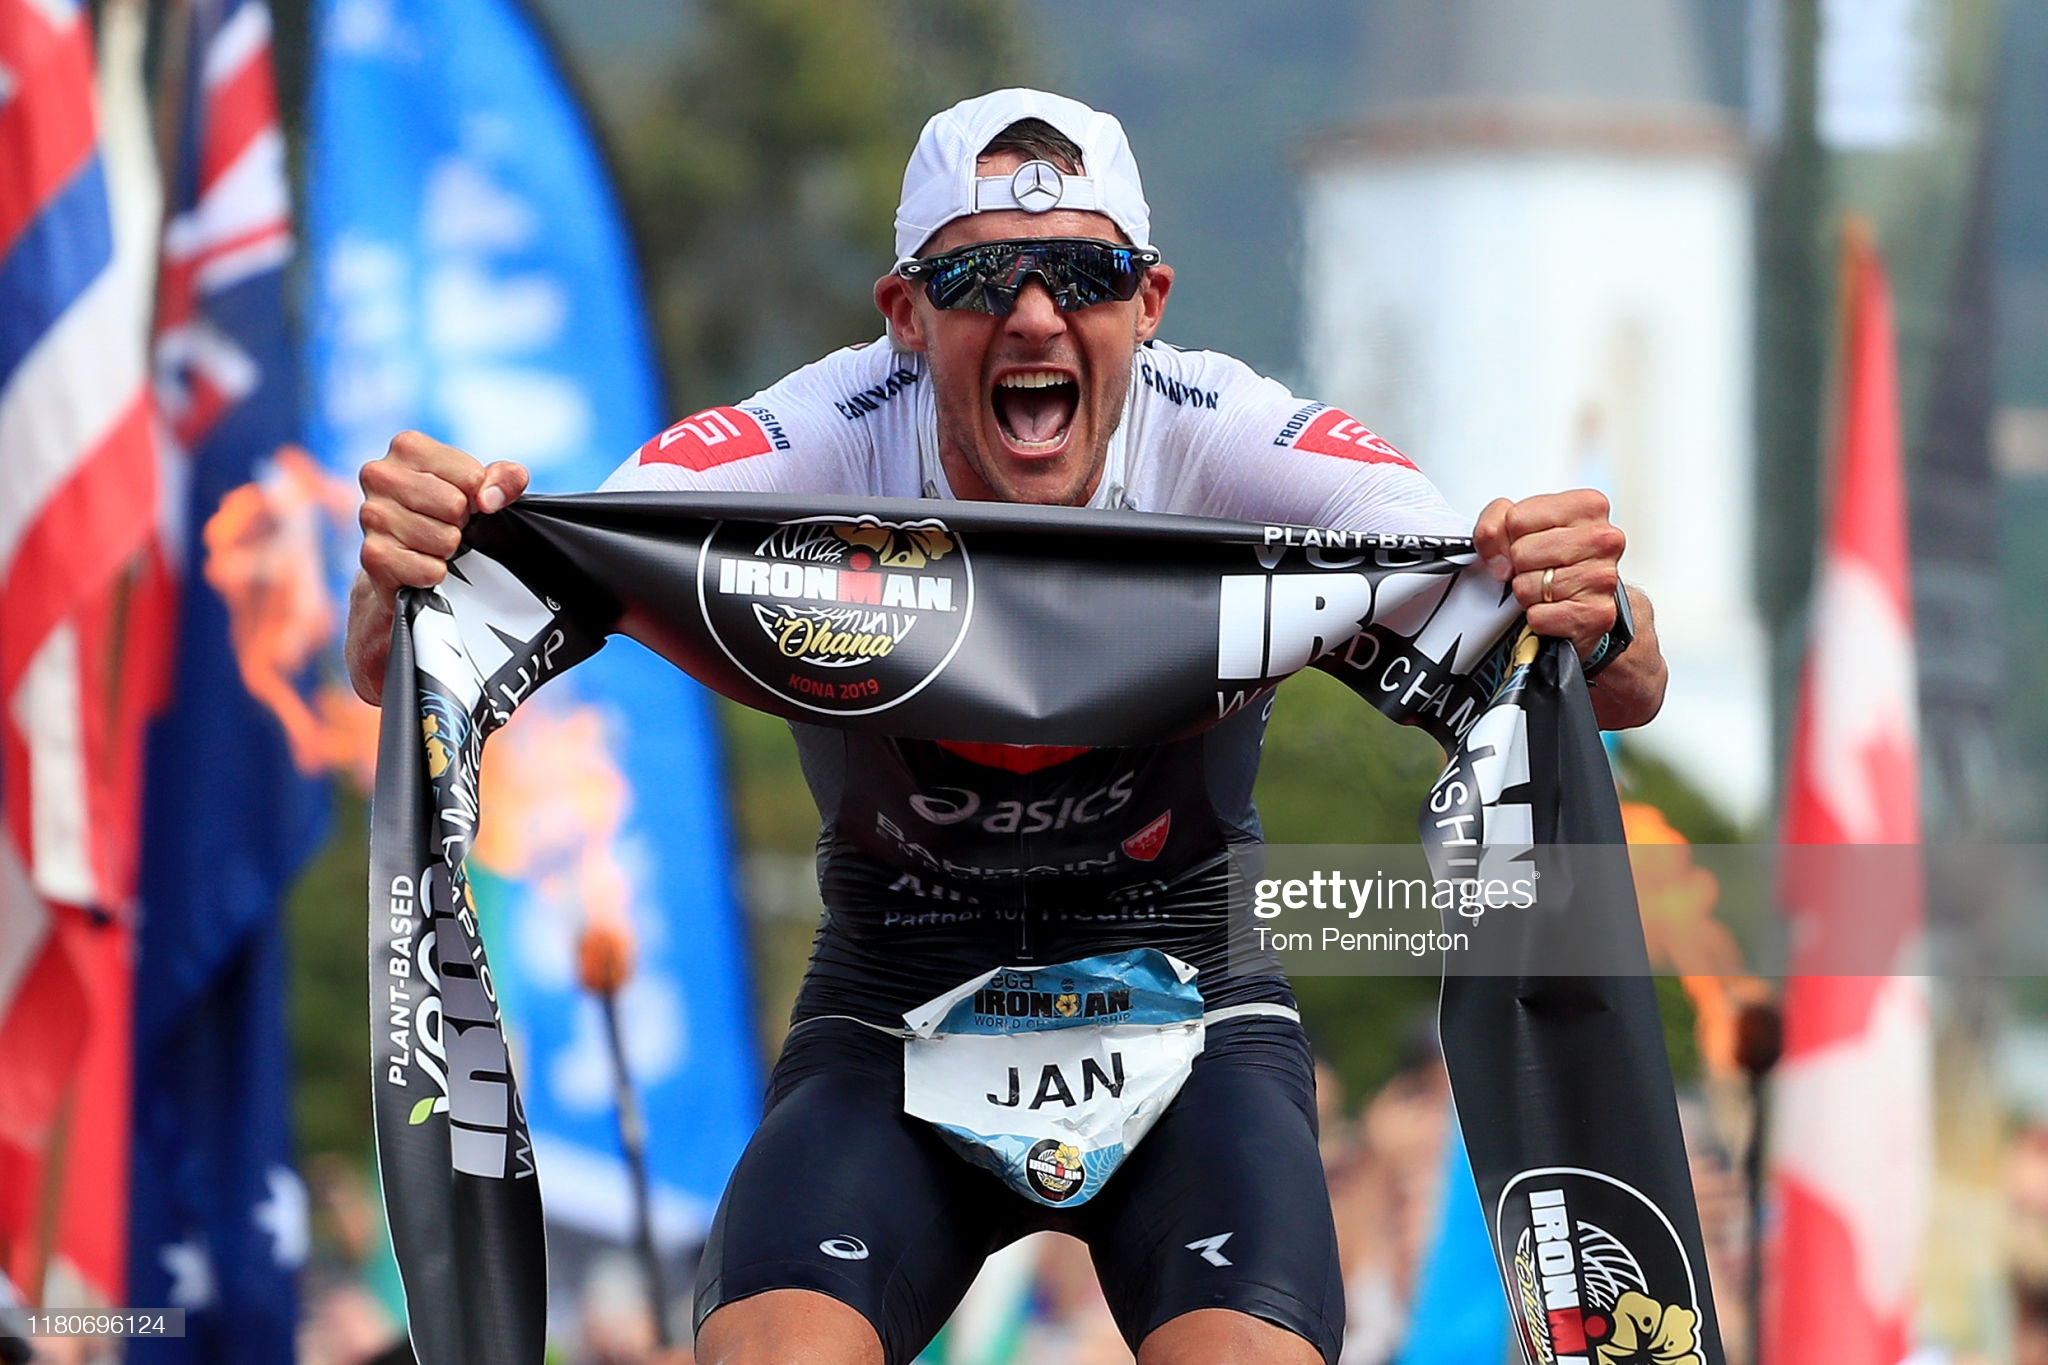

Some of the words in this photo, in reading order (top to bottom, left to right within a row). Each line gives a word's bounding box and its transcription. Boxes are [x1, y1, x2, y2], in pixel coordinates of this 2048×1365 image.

[718, 553, 957, 612] IRONMAN
[788, 673, 835, 699] KONA
[839, 678, 880, 699] 2019
[982, 769, 1135, 834] asics
[388, 874, 414, 1087] PLANT-BASED
[986, 1052, 1125, 1110] JAN
[1528, 1189, 1594, 1365] IRONM
